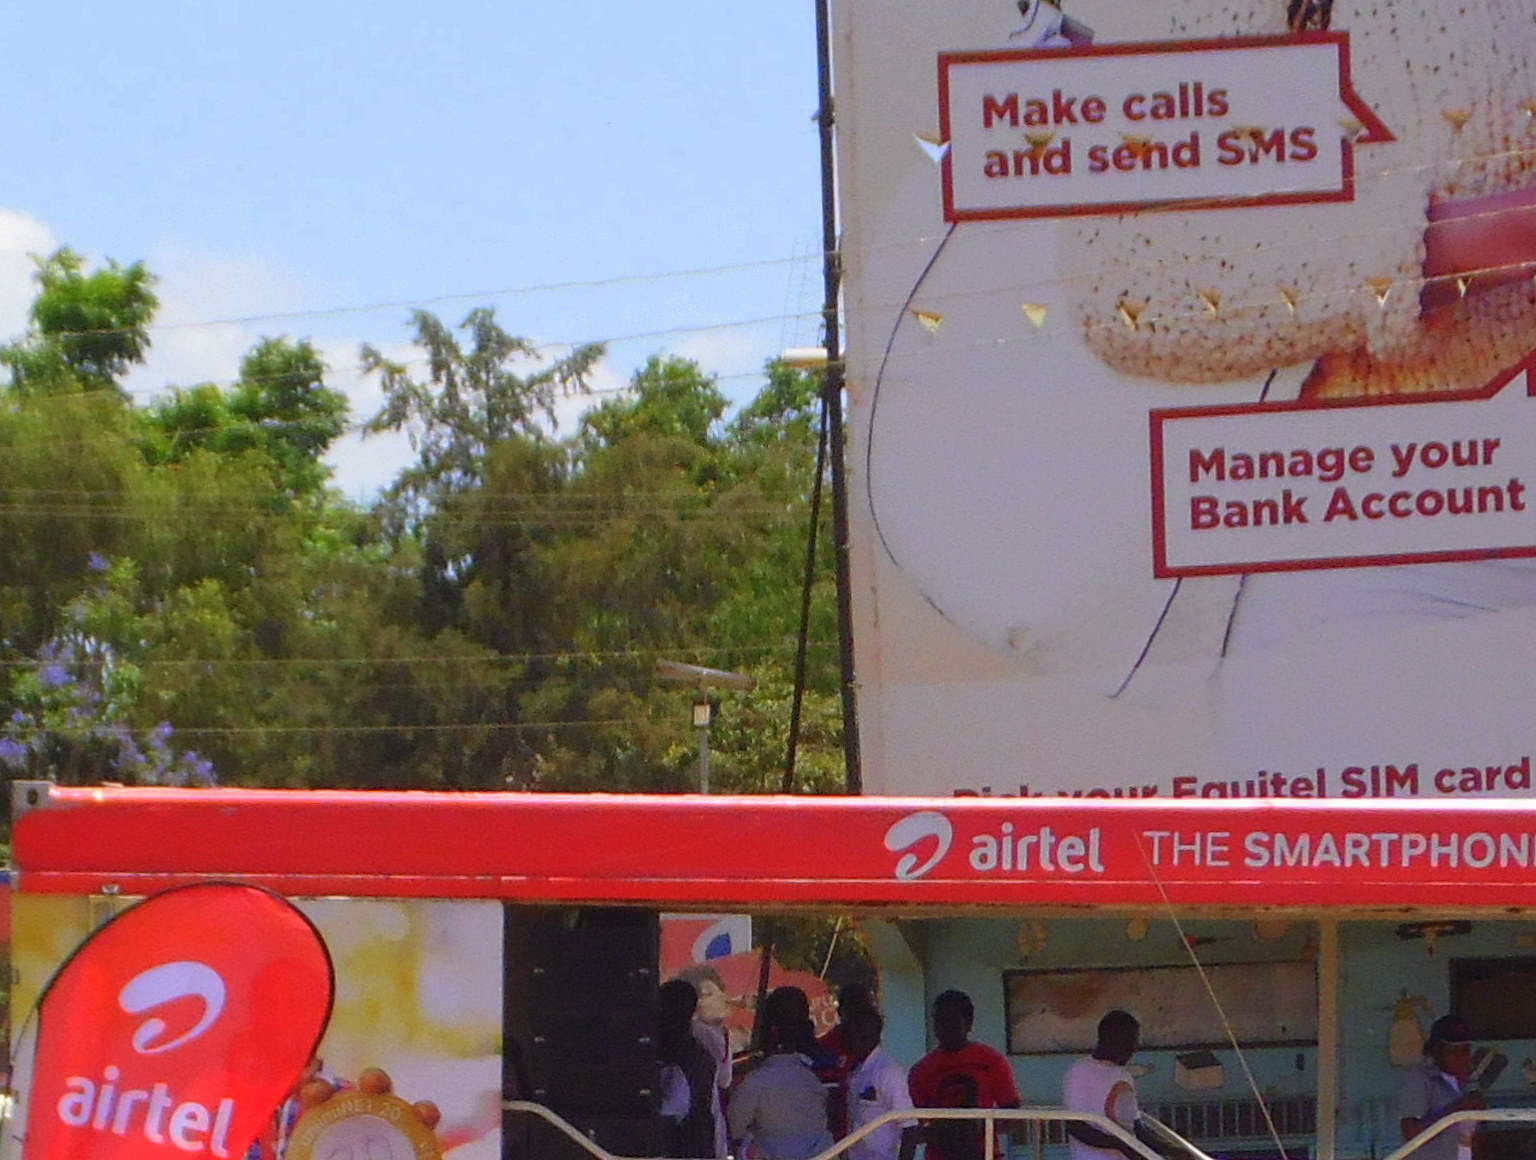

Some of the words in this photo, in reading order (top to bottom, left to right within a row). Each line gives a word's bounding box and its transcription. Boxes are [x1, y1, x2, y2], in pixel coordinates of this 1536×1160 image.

[982, 89, 1107, 129] Make
[1122, 82, 1230, 122] calls
[983, 139, 1072, 178] and
[1087, 130, 1202, 173] send
[1216, 126, 1318, 166] SMS
[1189, 444, 1375, 483] Manage
[1390, 436, 1501, 478] your
[1190, 488, 1308, 531] Bank
[1323, 477, 1526, 522] Account
[1340, 763, 1419, 799] SIM
[1433, 753, 1532, 794] card
[969, 821, 1104, 873] airtel
[1142, 830, 1230, 867] THE
[57, 1065, 236, 1160] airtel
[379, 1101, 402, 1120] 20
